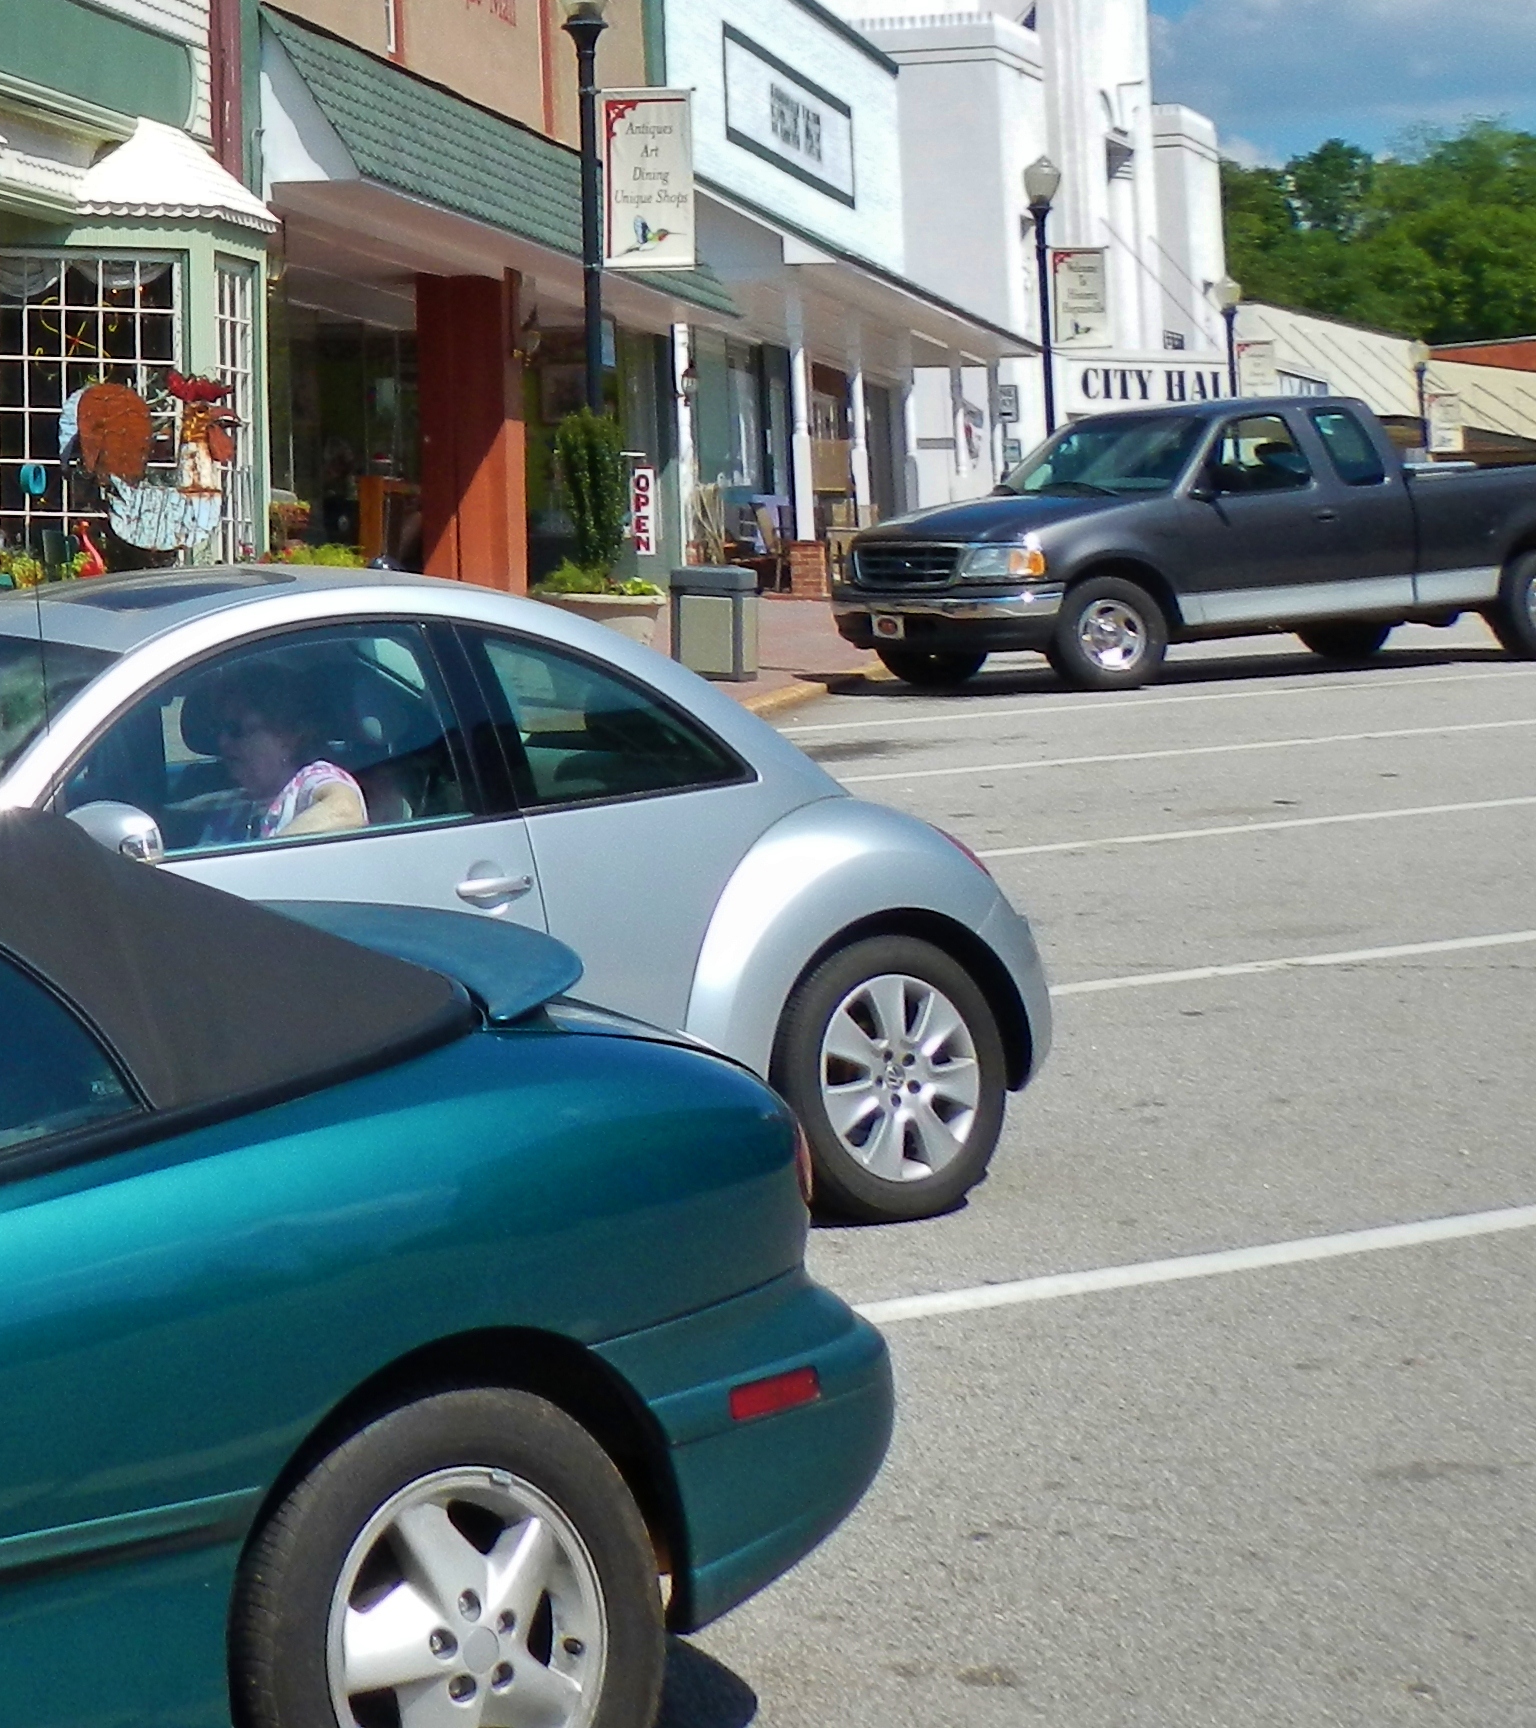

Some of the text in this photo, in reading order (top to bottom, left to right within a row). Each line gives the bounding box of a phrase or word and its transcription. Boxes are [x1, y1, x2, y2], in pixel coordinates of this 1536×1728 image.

[626, 122, 673, 139] Antiques
[640, 144, 659, 158] Art
[632, 166, 670, 186] Dining
[614, 189, 688, 208] Unique Shops
[1081, 367, 1229, 401] CITY HAL
[634, 473, 651, 552] OPEN
